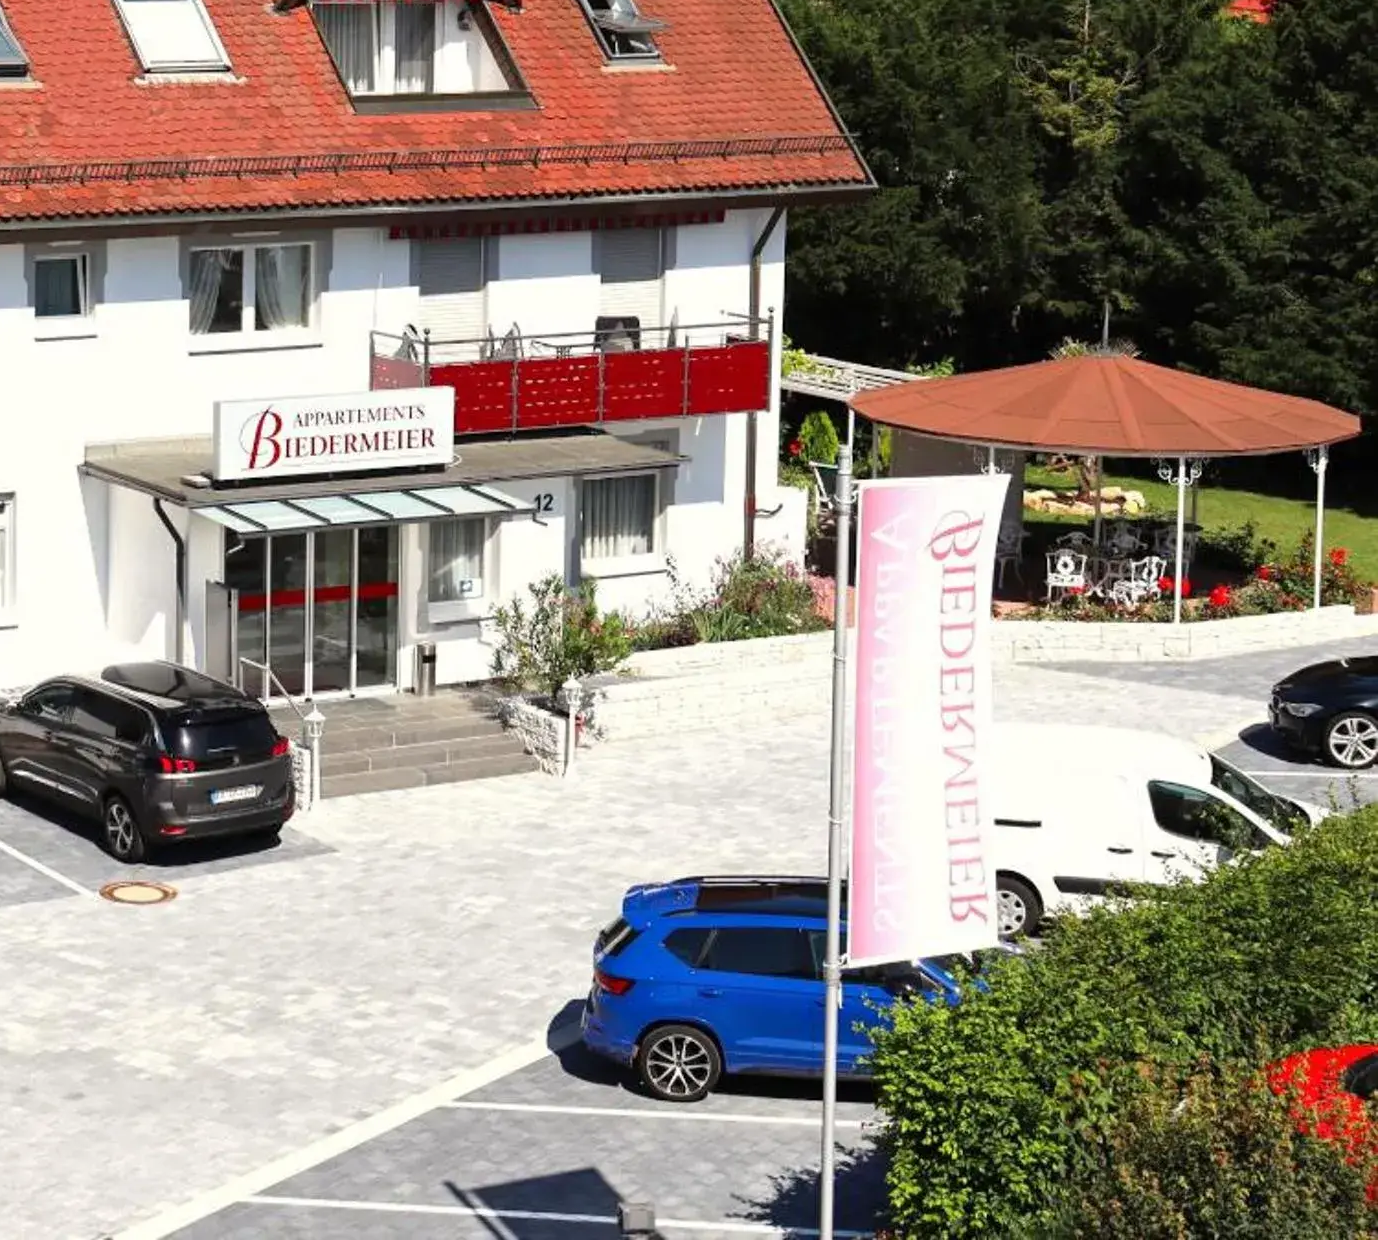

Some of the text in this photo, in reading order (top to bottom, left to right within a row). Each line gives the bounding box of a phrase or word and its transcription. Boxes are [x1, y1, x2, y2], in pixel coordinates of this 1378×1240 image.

[292, 404, 426, 429] APPARTEMENTS
[238, 404, 436, 472] BIEDERMEIER
[534, 493, 554, 512] 12
